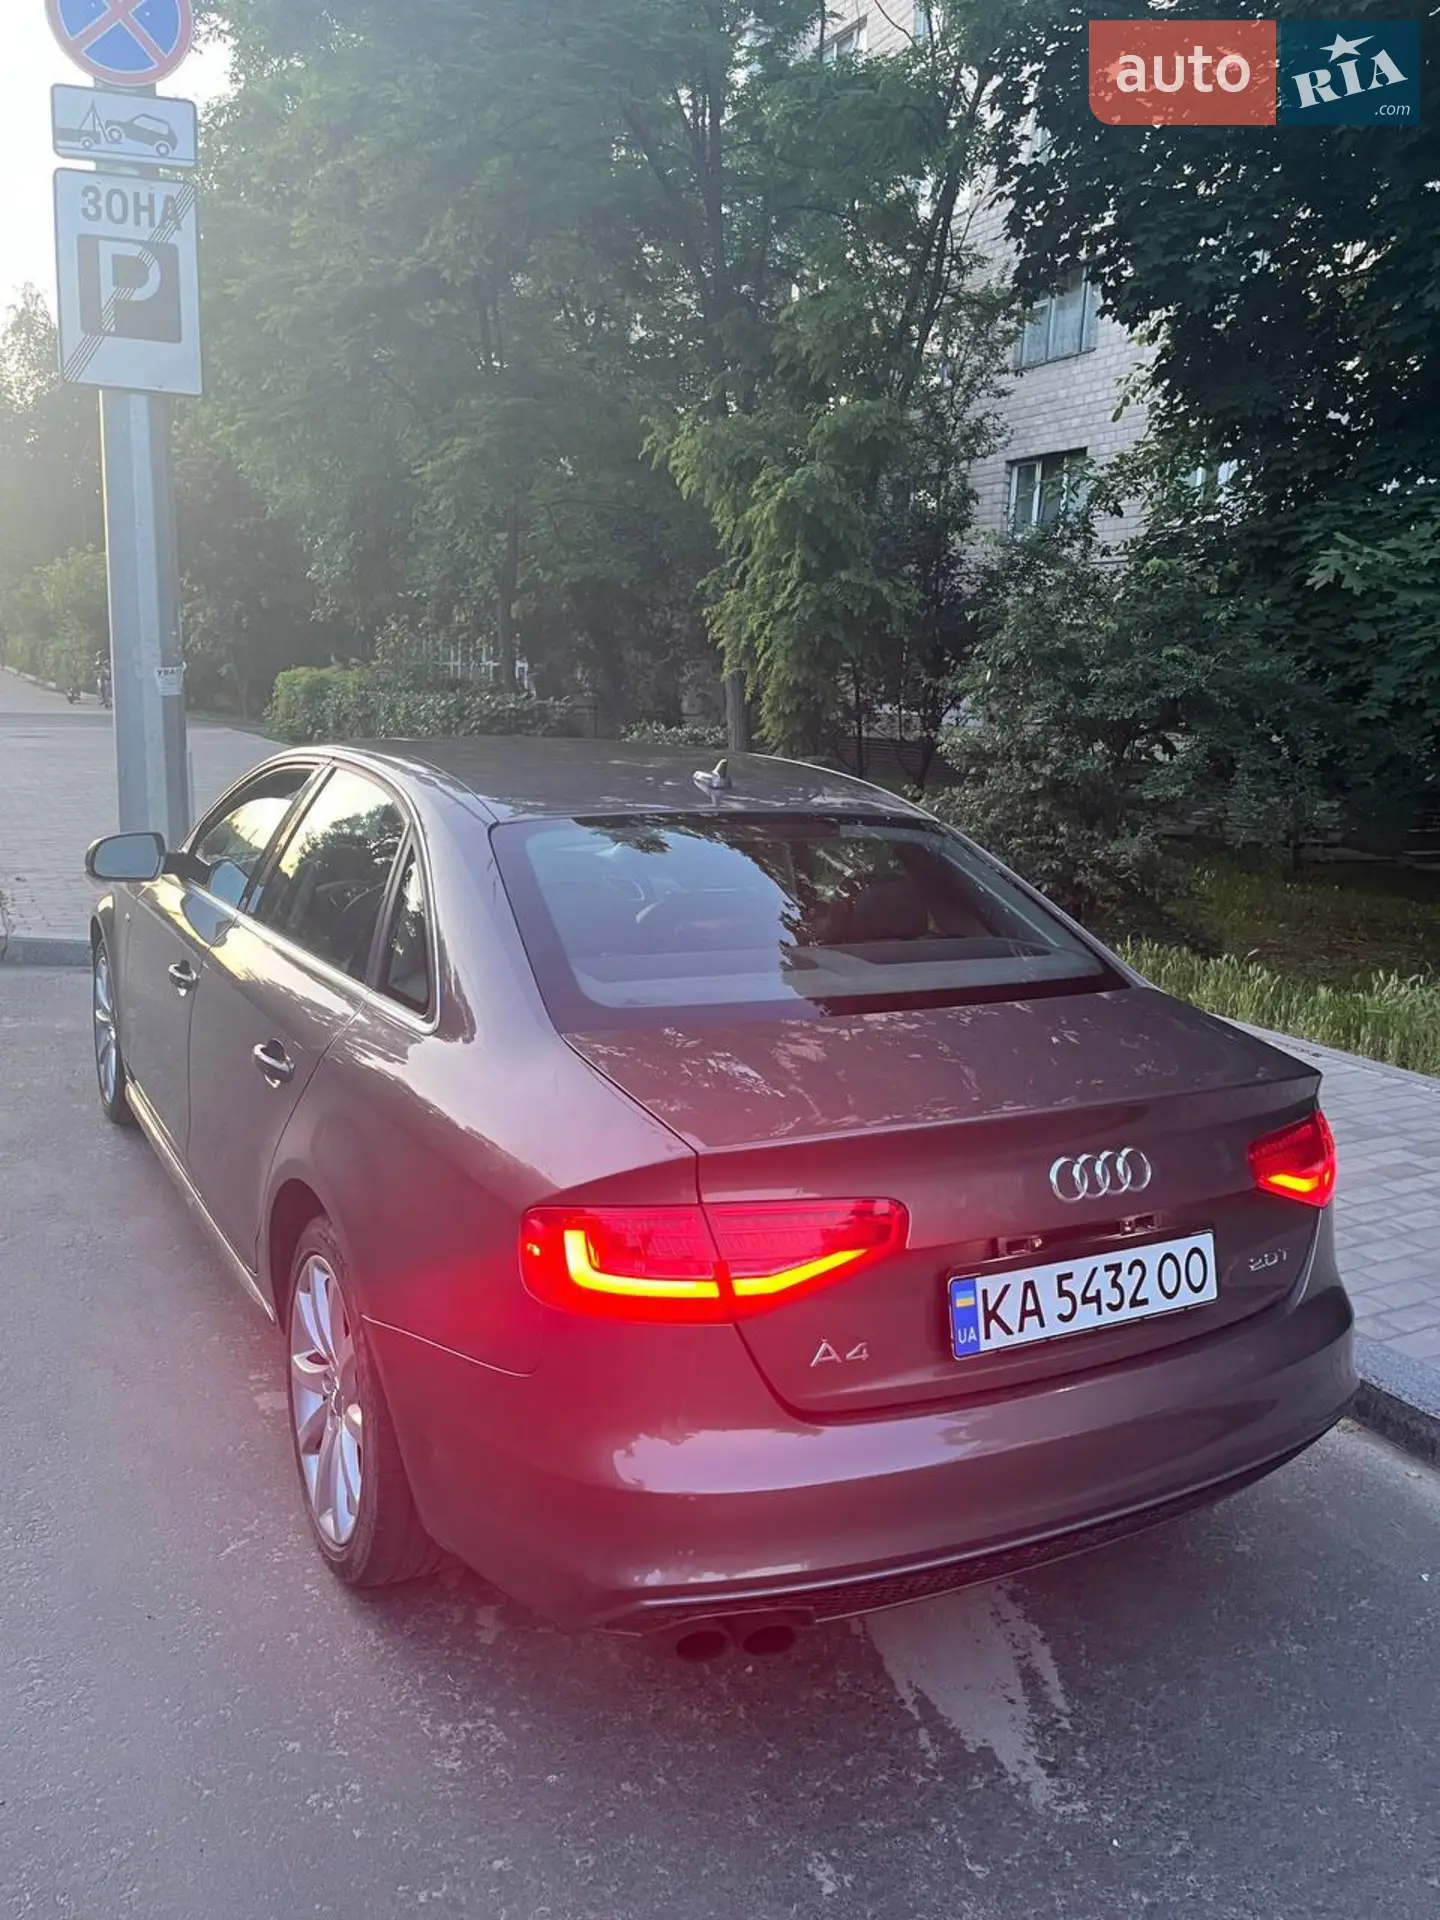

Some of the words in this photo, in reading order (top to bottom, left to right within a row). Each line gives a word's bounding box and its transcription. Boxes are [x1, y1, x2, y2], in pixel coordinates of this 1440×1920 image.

[81, 185, 182, 231] ЗОНА
[982, 1279, 1046, 1341] KA
[1056, 1258, 1149, 1324] 5432
[810, 1340, 870, 1367] A4
[957, 1327, 978, 1346] UA
